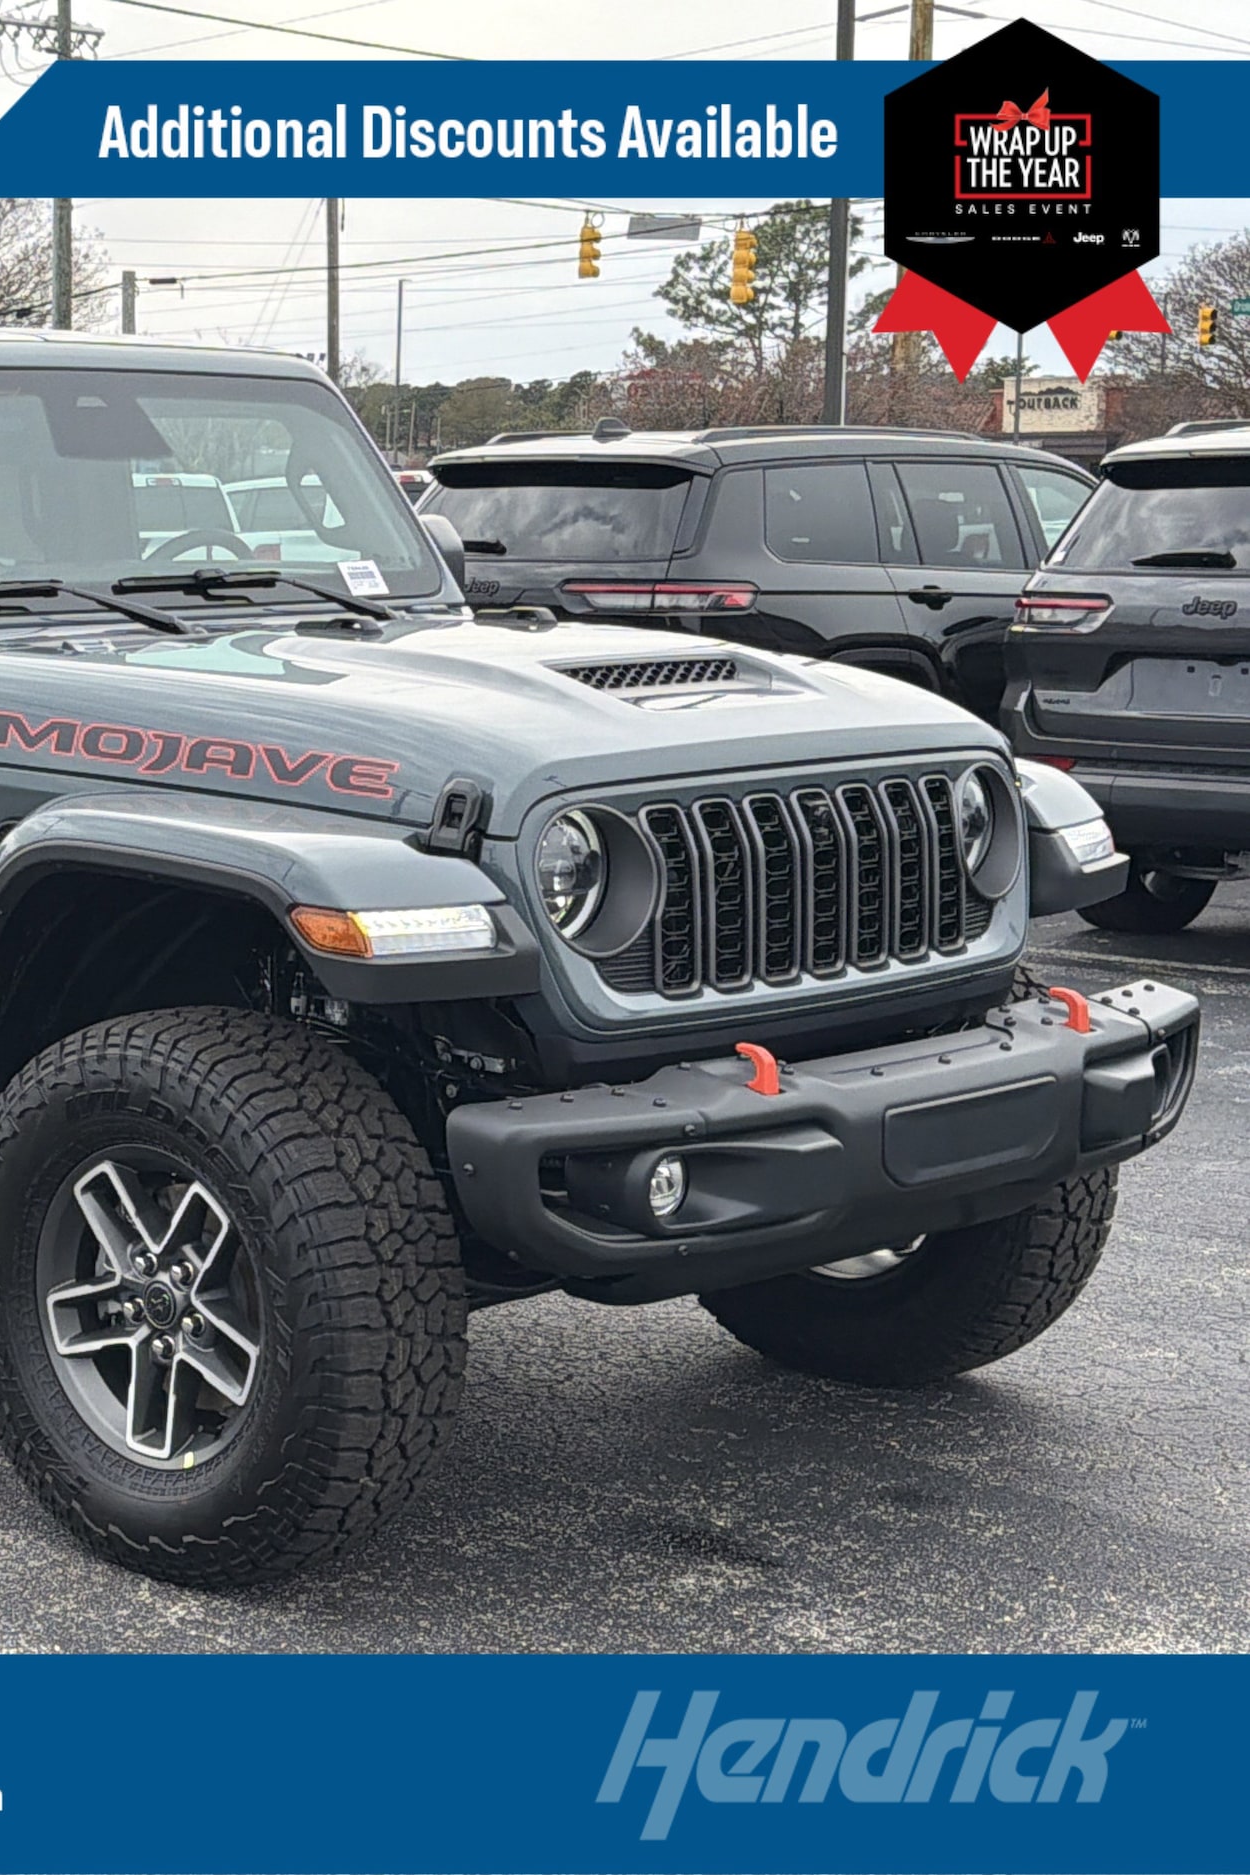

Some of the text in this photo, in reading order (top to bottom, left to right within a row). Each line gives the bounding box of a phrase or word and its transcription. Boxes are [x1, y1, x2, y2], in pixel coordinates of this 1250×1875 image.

[1018, 396, 1079, 411] OUTBACK
[463, 577, 501, 597] Jeep
[1182, 597, 1238, 620] Jeep
